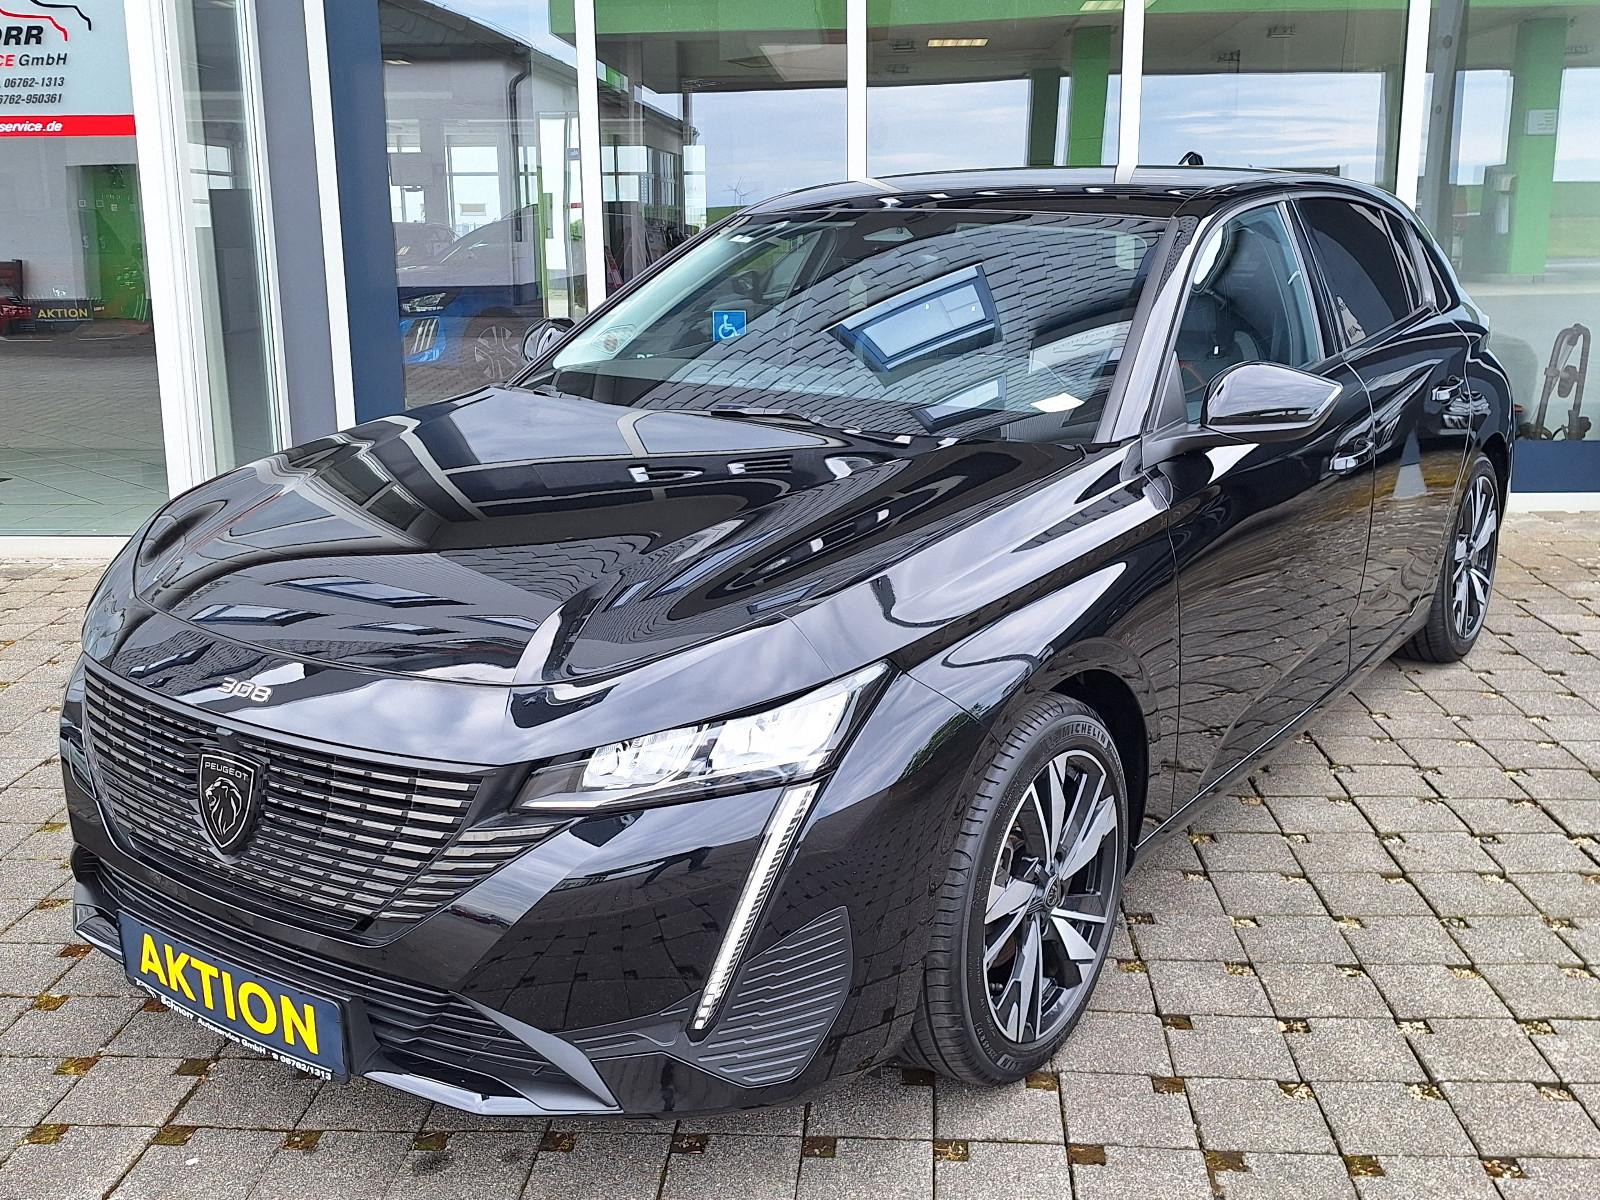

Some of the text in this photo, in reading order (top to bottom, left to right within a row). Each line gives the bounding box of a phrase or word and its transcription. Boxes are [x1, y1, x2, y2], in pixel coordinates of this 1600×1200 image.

[0, 26, 43, 46] RR
[19, 53, 67, 66] GmbH
[4, 77, 65, 88] 06762-1313
[0, 121, 63, 132] service.de
[37, 308, 88, 319] AKTION
[217, 677, 272, 702] 308
[1063, 723, 1107, 746] MICHELIN
[204, 761, 249, 780] PEUGEOT
[140, 933, 319, 1055] AKTION
[197, 1018, 240, 1043] Autoservice
[241, 1038, 266, 1055] GmbH
[280, 1055, 332, 1080] 06762/1313
